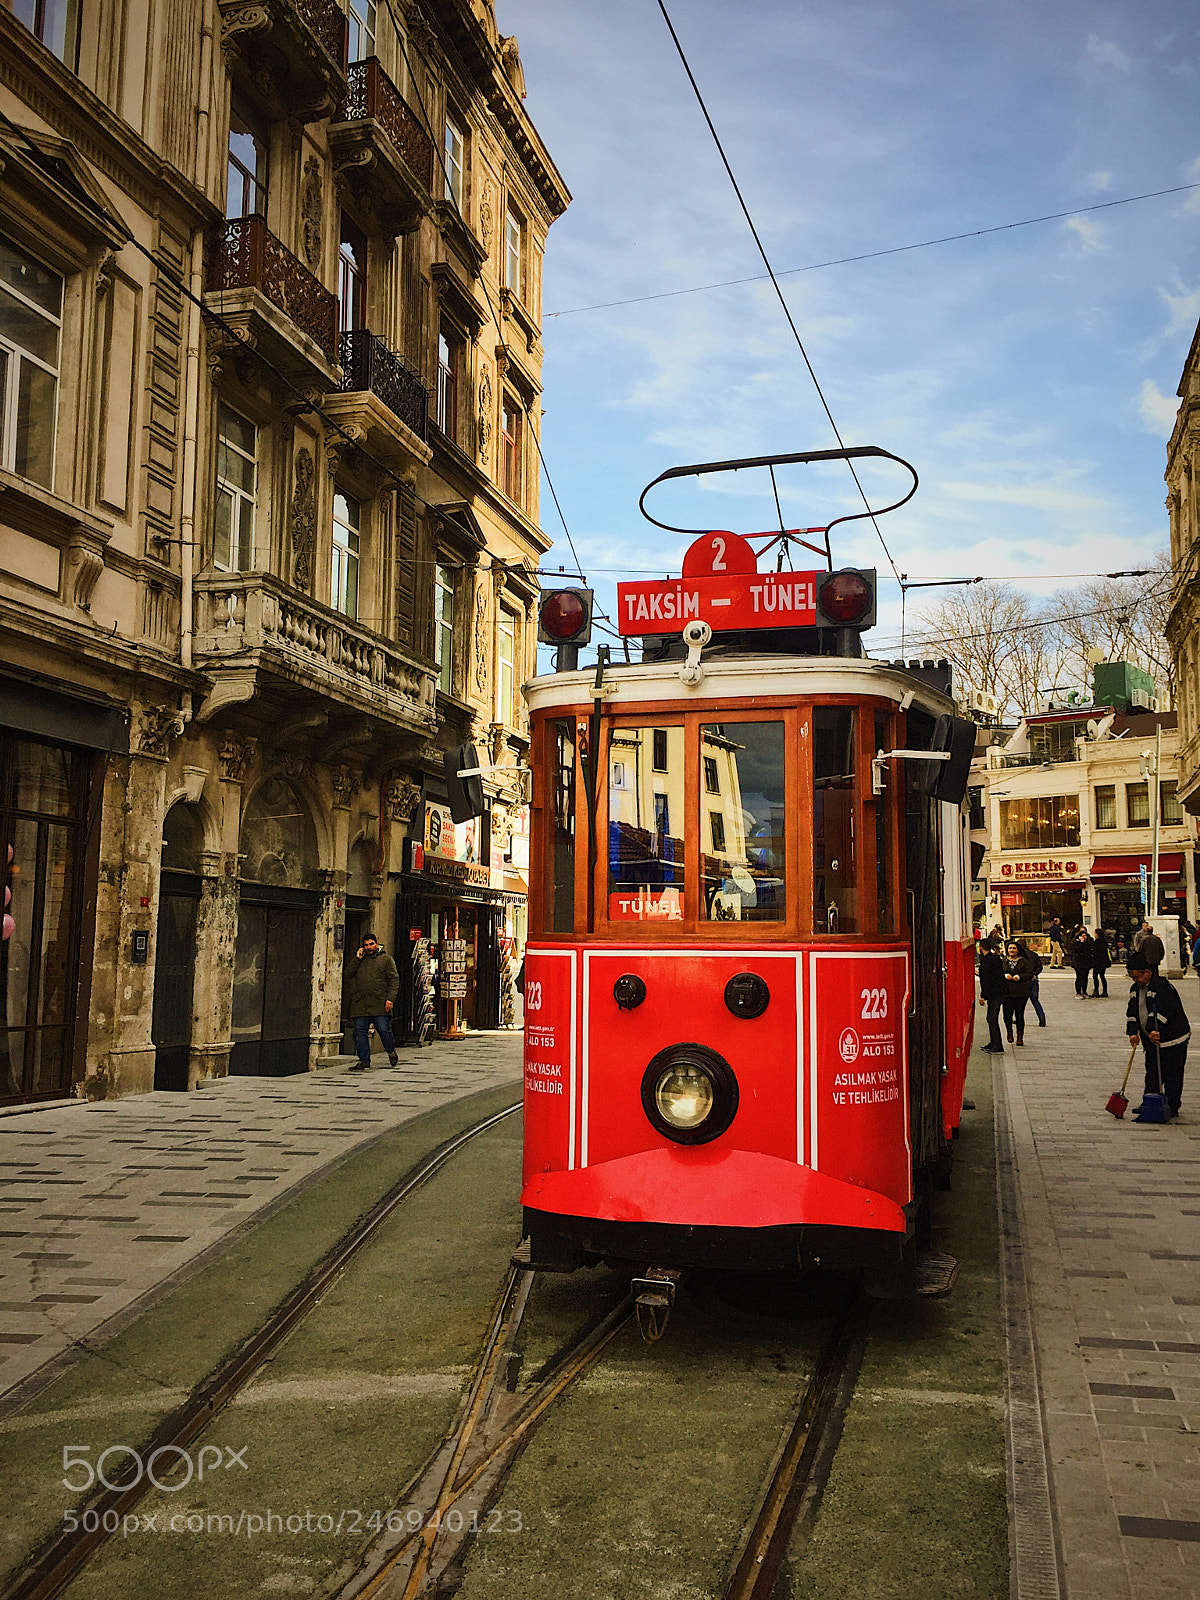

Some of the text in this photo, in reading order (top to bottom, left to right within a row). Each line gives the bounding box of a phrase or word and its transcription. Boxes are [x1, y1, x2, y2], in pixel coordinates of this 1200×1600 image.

[711, 537, 727, 571] 2
[625, 585, 699, 620] TAKSİM
[750, 577, 816, 612] TÜNEL
[1014, 859, 1063, 873] KESKİN
[618, 897, 682, 914] TÜNEL
[861, 988, 888, 1019] 223
[528, 1036, 555, 1048] ALO 153
[862, 1045, 895, 1056] ALO 153
[537, 1063, 562, 1077] YASAK
[834, 1069, 898, 1086] ASILMAK YASAK
[832, 1084, 899, 1105] VE TEHLİKELİDİR
